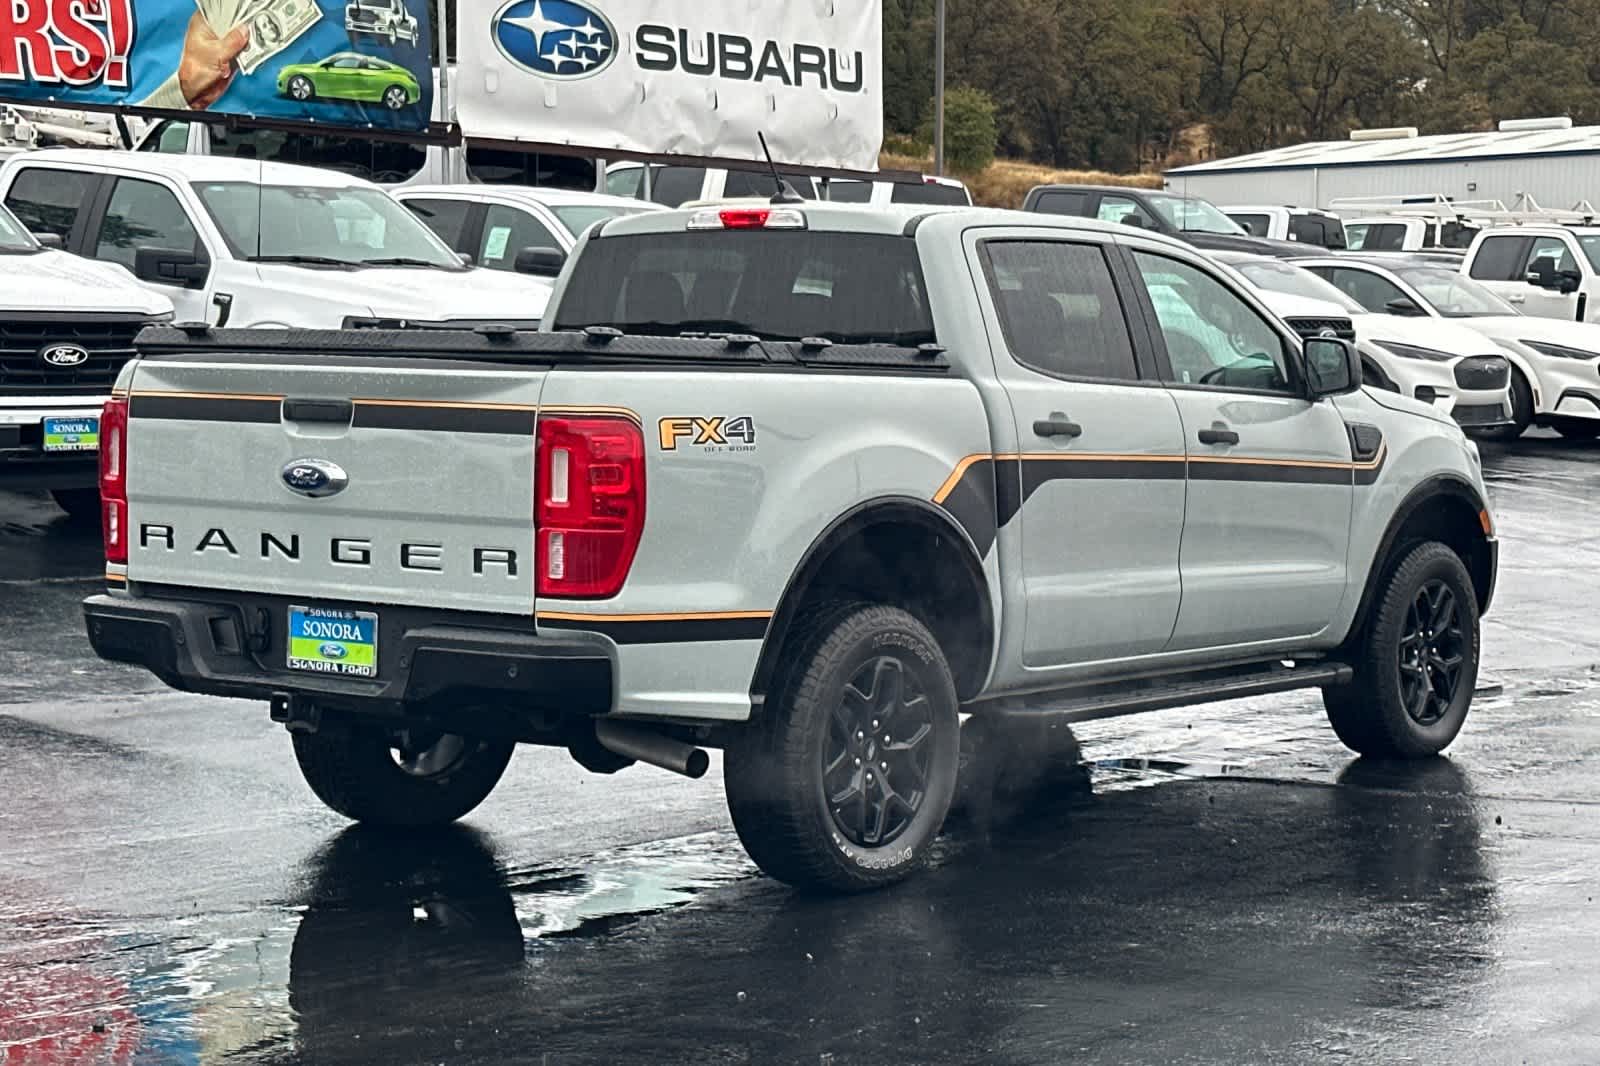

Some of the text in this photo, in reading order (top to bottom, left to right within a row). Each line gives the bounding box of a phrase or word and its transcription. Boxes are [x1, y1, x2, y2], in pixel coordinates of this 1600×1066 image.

[635, 23, 864, 93] SUBARU
[52, 348, 80, 362] Ford
[53, 423, 90, 433] SONORA
[658, 416, 756, 451] FX4
[140, 523, 518, 577] RANGER
[309, 608, 343, 618] SONORA
[303, 620, 363, 641] SONORA
[292, 660, 370, 676] SONORA FORD
